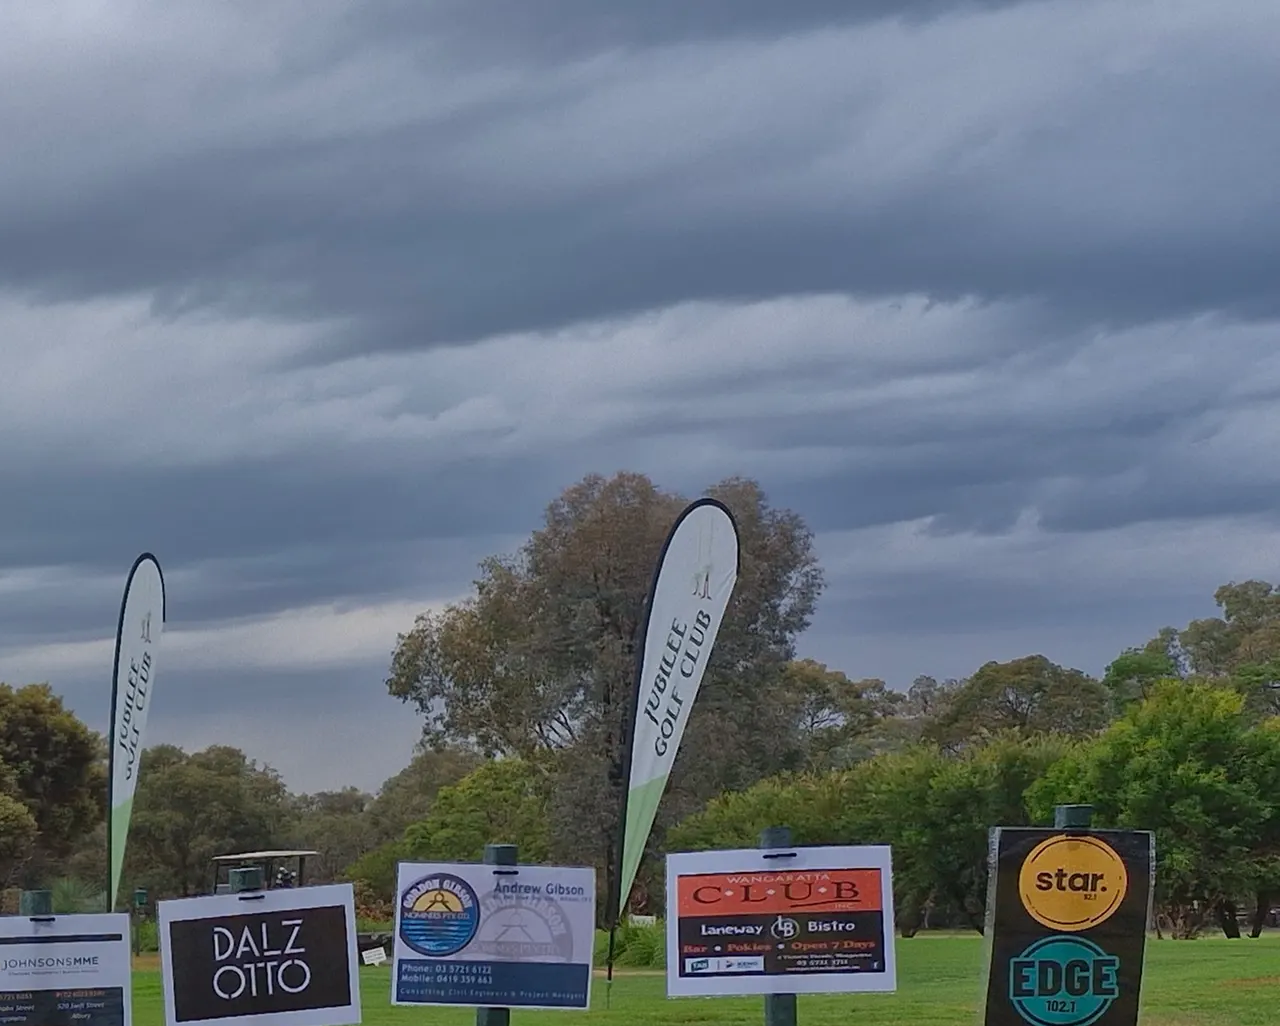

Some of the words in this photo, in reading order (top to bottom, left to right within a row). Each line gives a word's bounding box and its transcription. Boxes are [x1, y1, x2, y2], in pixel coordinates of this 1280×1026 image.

[135, 654, 153, 713] CLUB
[644, 617, 688, 726] JUBILEE
[654, 686, 685, 757] GOLF
[680, 609, 712, 680] CLUB
[117, 657, 139, 750] JUBILEE
[494, 881, 541, 894] Andrew
[545, 882, 584, 895] Gibson
[726, 873, 831, 884] WANGARATTA
[1035, 868, 1108, 892] star.
[213, 919, 306, 961] DALZ
[701, 924, 763, 936] Laneway
[808, 920, 856, 932] Bistro
[683, 944, 708, 953] Bar
[727, 942, 772, 952] Pokies
[791, 942, 828, 951] Open
[843, 941, 876, 950] Days
[213, 959, 311, 999] OTTO
[401, 974, 434, 983] Mobile:
[436, 975, 458, 984] 0419
[460, 975, 476, 984] 359
[402, 964, 433, 973] Phone:
[435, 964, 447, 973] 03
[449, 965, 469, 974] 5721
[1013, 958, 1117, 998] EDGE
[1046, 1000, 1077, 1013] 102.1
